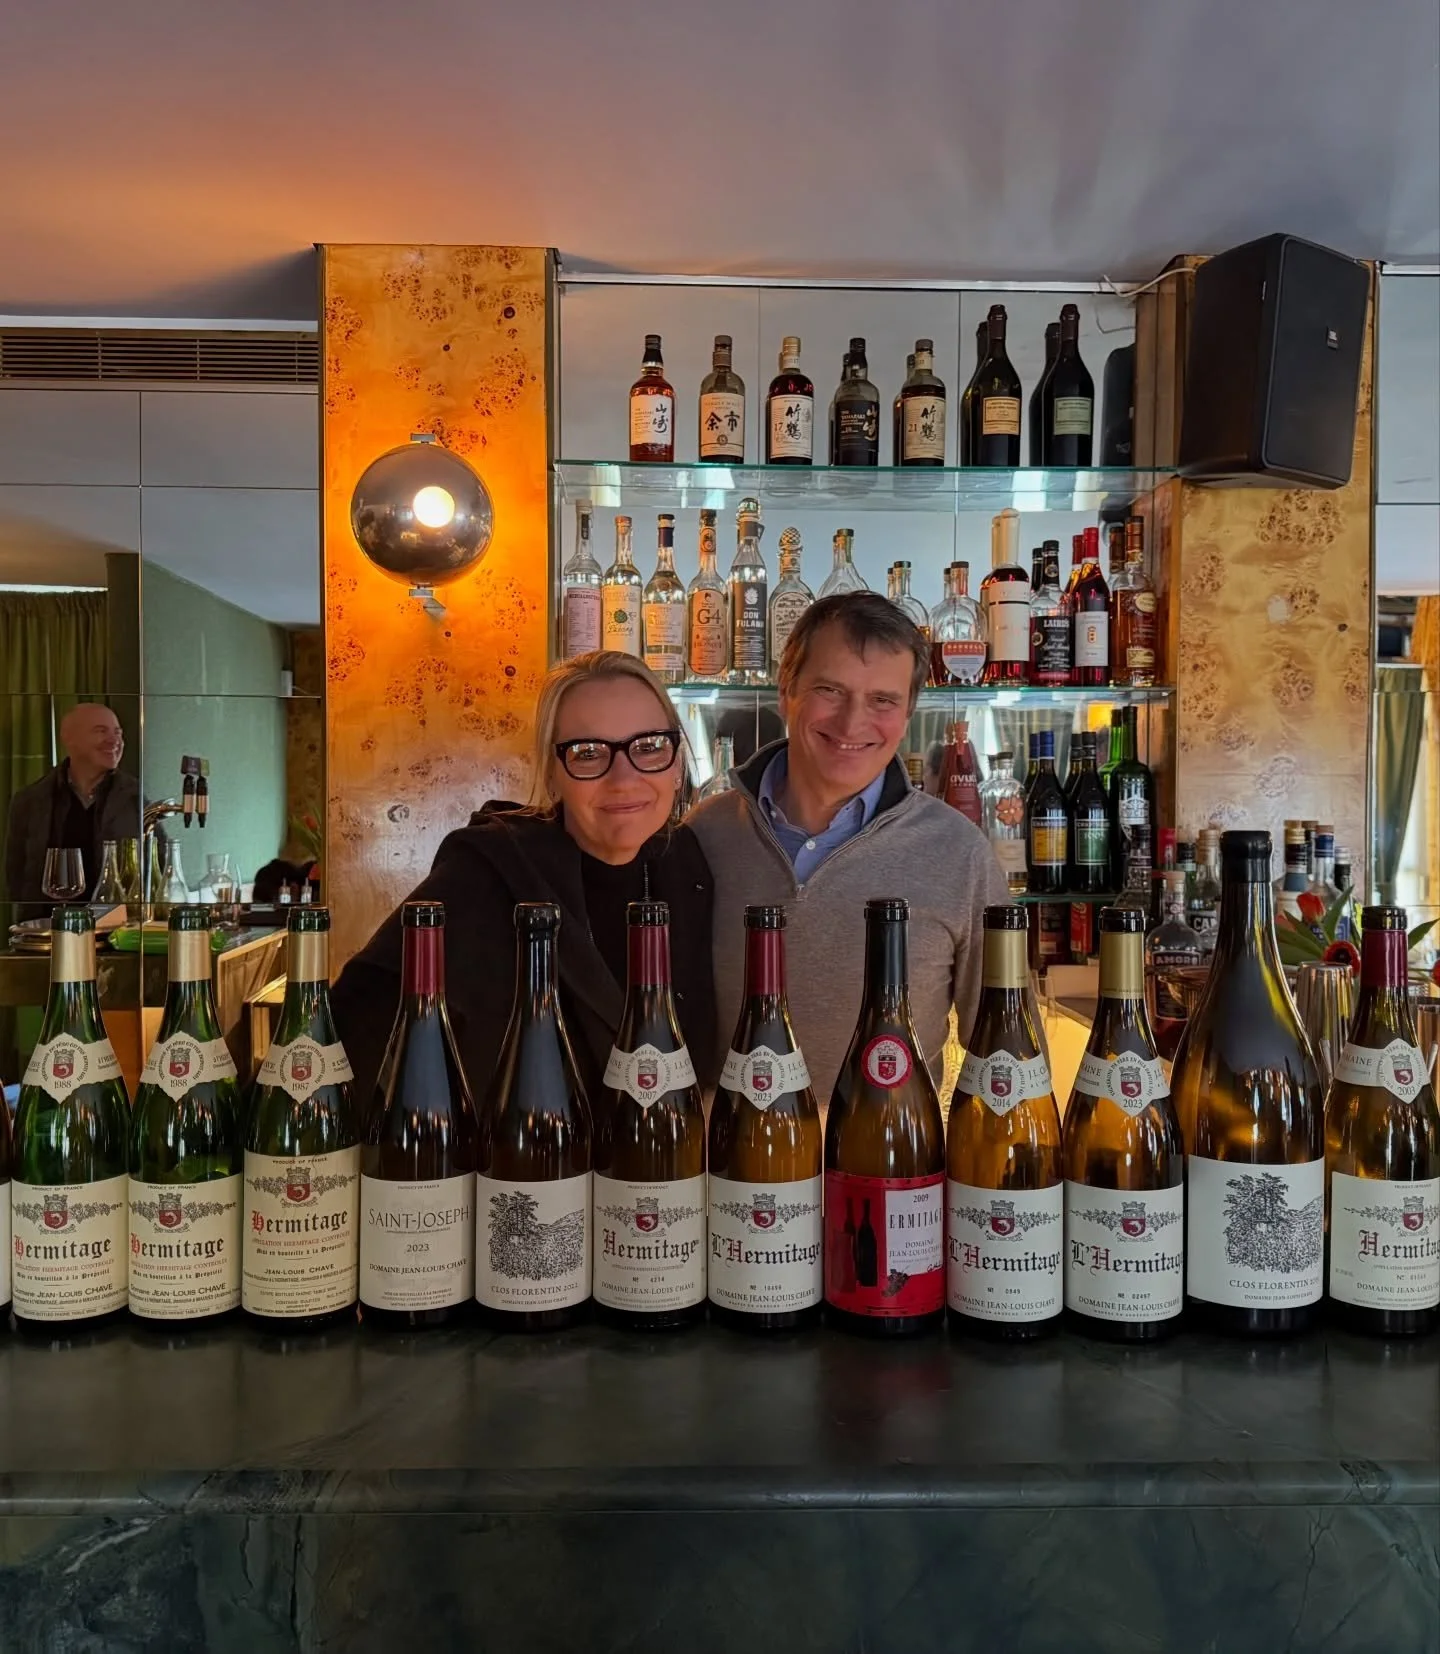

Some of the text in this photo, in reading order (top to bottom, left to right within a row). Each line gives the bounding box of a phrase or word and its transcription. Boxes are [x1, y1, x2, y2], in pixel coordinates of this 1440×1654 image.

[704, 410, 740, 432] 余市
[774, 422, 784, 433] 17
[908, 423, 918, 433] 21
[697, 608, 721, 625] G4
[744, 611, 759, 619] DON
[54, 1080, 72, 1089] 1988
[170, 1080, 188, 1088] 1988
[638, 1091, 657, 1100] 2007
[992, 1098, 1010, 1107] 2014
[1124, 1100, 1143, 1109] 2023
[913, 1194, 929, 1203] 2009
[252, 1210, 348, 1235] Hermitage
[368, 1204, 470, 1230] SAINT-JOSEPH
[14, 1234, 112, 1260] Hermitage
[130, 1232, 224, 1258] Hermitage
[406, 1244, 430, 1253] 2023
[603, 1228, 699, 1264] Hermitage
[309, 1263, 335, 1274] CHAVE
[370, 1258, 467, 1275] DOMAINE JEAN-LOUIS CHAVE
[37, 1290, 83, 1298] JEAN-LOUIS
[85, 1283, 113, 1295] CHAVE
[152, 1289, 196, 1297] JEAN-LOUIS
[198, 1282, 227, 1295] CHAVE
[491, 1285, 510, 1295] CLOS
[512, 1286, 562, 1296] FLORENTIN
[602, 1281, 695, 1295] DOMAINE JEAN-LOUIS CHAVE
[1230, 1279, 1309, 1290] CLOS FLORENTIN
[1357, 1282, 1395, 1294] DOMAINE
[716, 1288, 815, 1303] DOMAINE JEAN-LOUIS CHAVE
[987, 1302, 1034, 1310] JEAN-LOUIS
[1035, 1298, 1055, 1309] CHAVE
[1079, 1296, 1117, 1310] DOMAINE
[1118, 1302, 1164, 1311] JEAN-LOUIS
